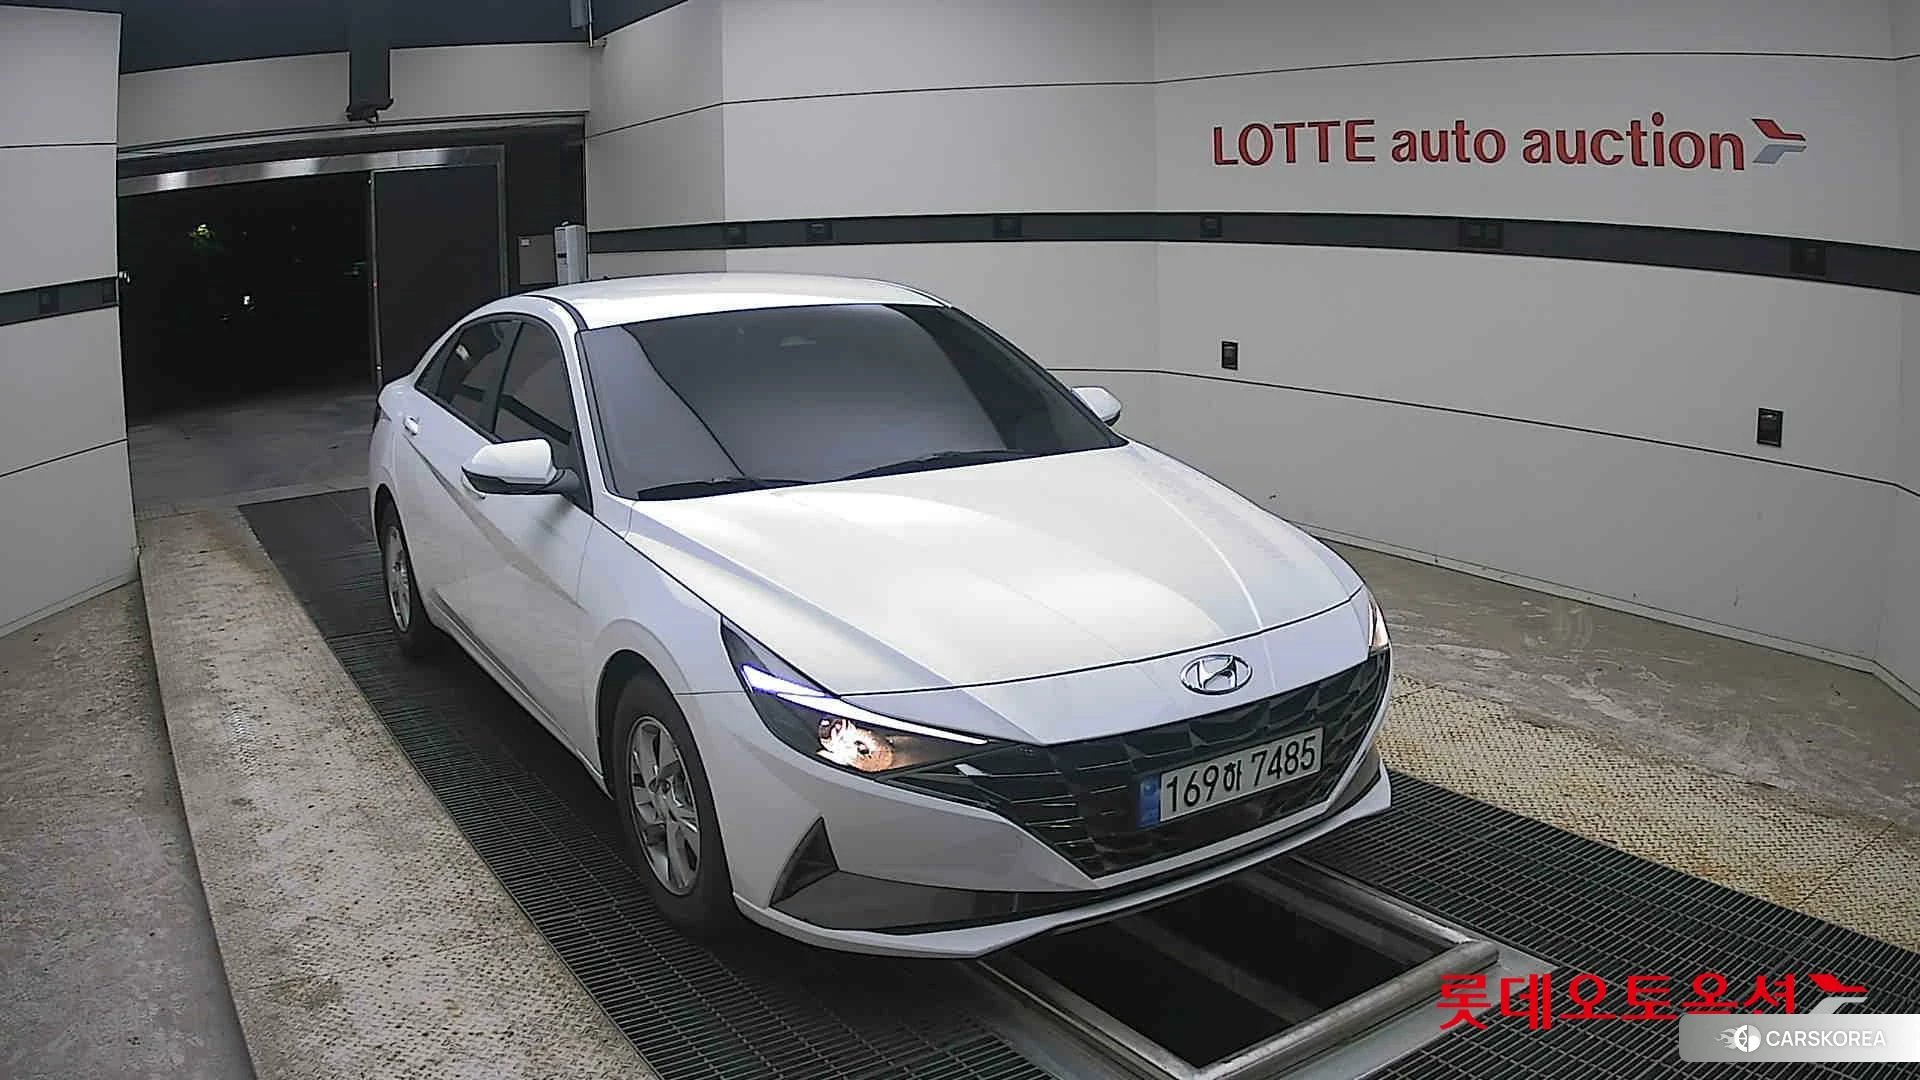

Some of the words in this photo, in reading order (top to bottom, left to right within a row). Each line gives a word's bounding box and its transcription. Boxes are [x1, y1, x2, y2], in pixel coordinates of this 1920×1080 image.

[1213, 119, 1376, 166] LOTTE
[1391, 119, 1506, 163] auto
[1522, 111, 1745, 171] auction
[1166, 759, 1243, 812] 169하
[1250, 735, 1317, 787] 7485
